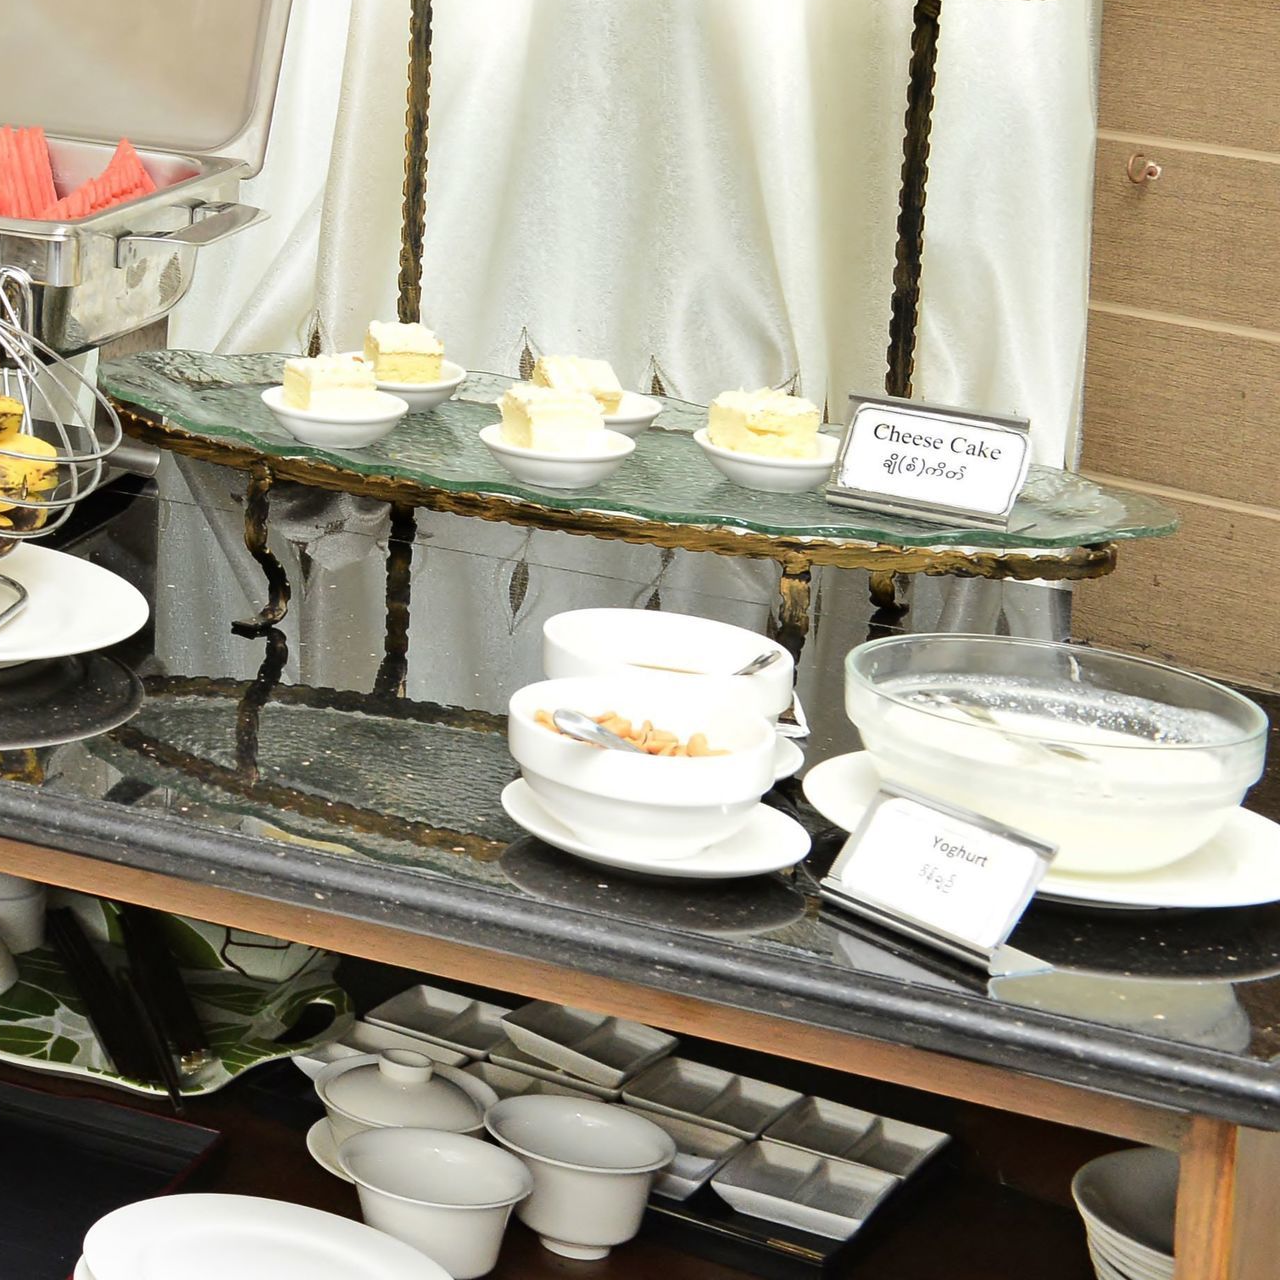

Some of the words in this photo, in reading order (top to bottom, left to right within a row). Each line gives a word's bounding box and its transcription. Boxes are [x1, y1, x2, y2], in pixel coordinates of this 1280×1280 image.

[873, 423, 944, 450] Cheese
[950, 435, 1002, 461] Cake
[930, 835, 989, 868] Yoghurt
